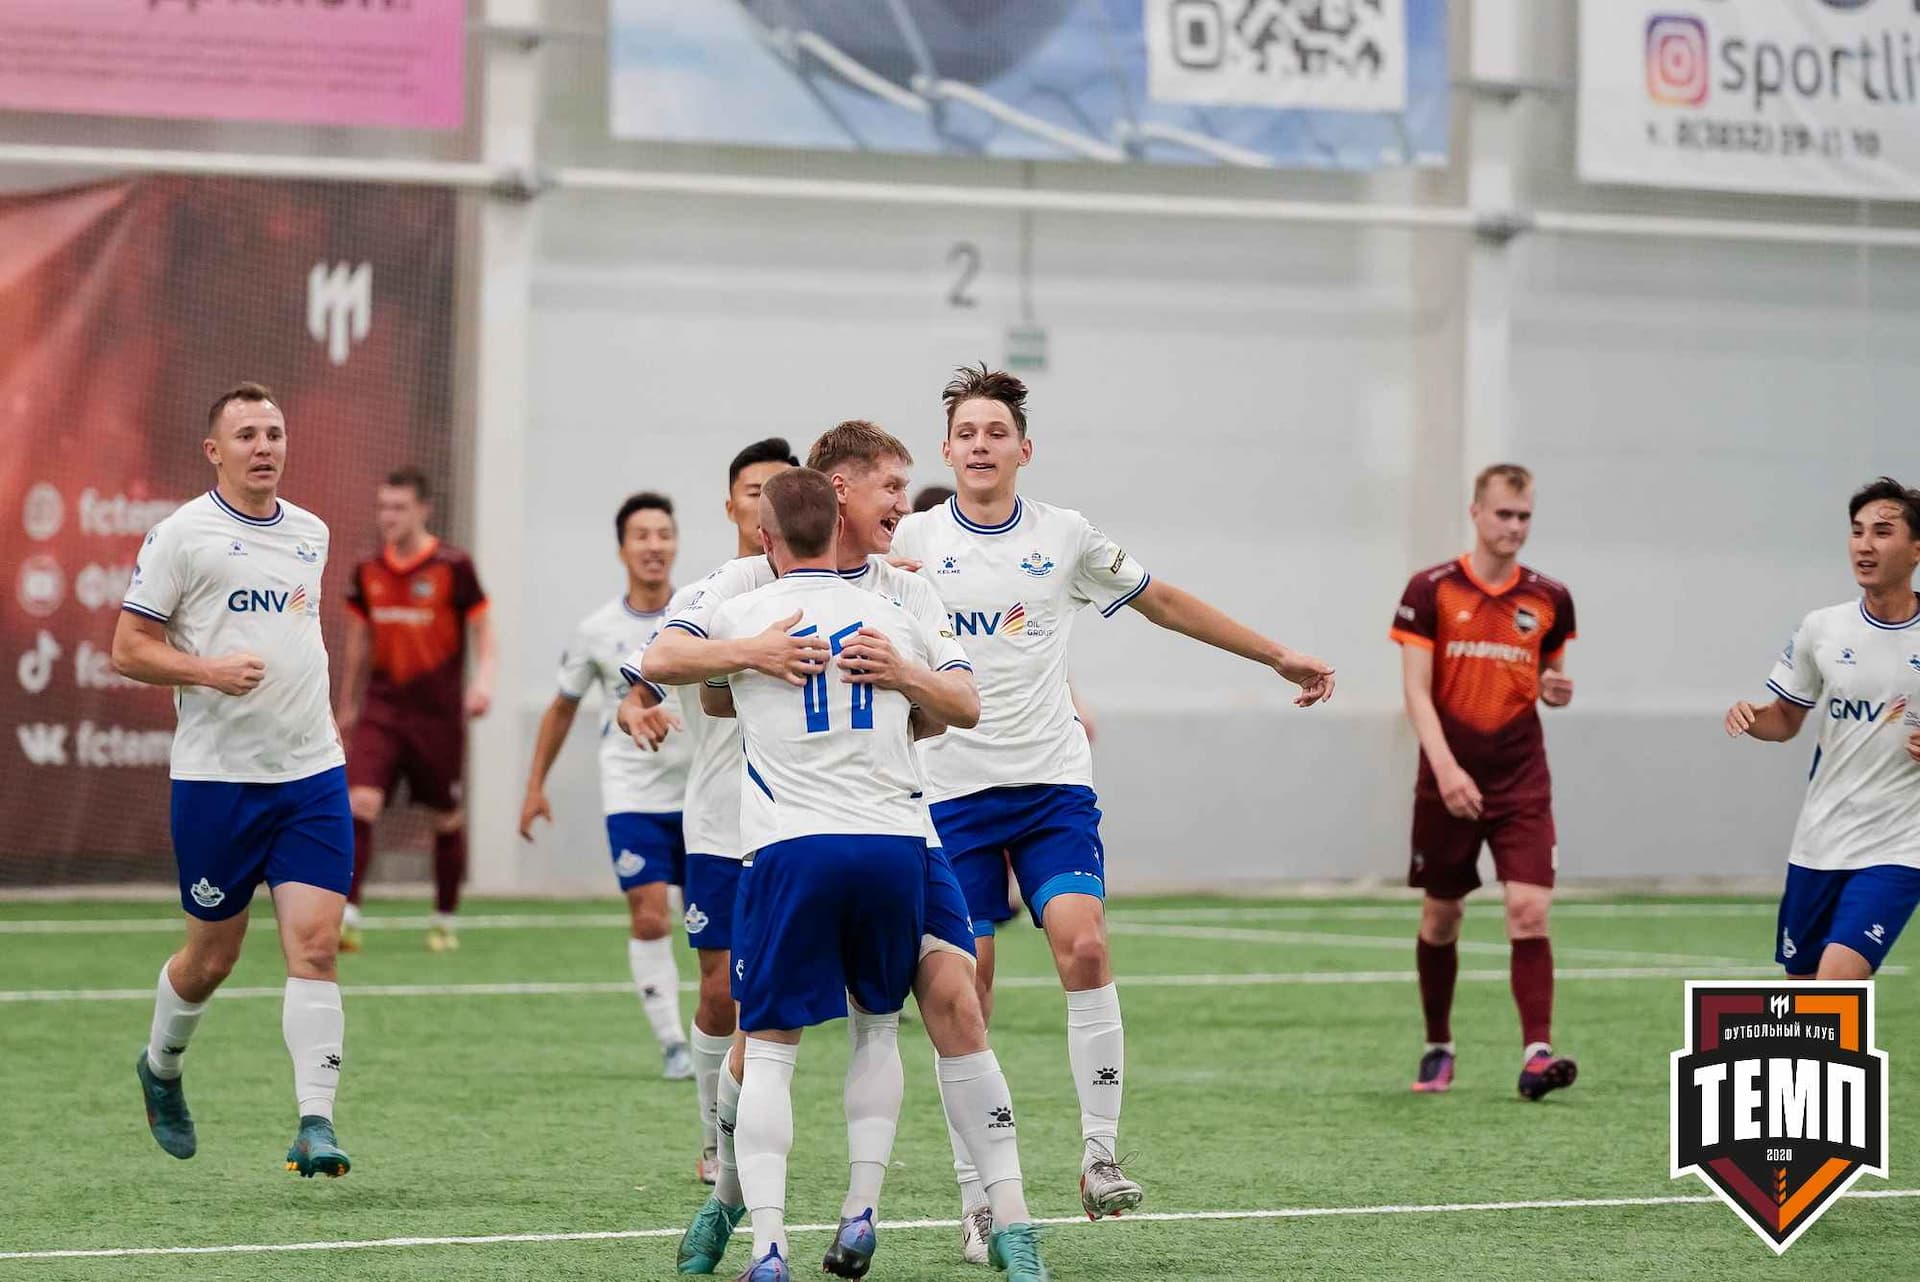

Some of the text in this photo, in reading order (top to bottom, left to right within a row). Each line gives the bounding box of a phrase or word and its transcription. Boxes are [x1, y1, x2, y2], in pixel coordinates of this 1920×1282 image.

[1720, 29, 1920, 111] sportli
[946, 242, 981, 308] 2
[228, 590, 289, 613] GNV
[947, 611, 1002, 636] NV
[1829, 698, 1886, 722] GNV
[987, 1121, 1016, 1129] KELM
